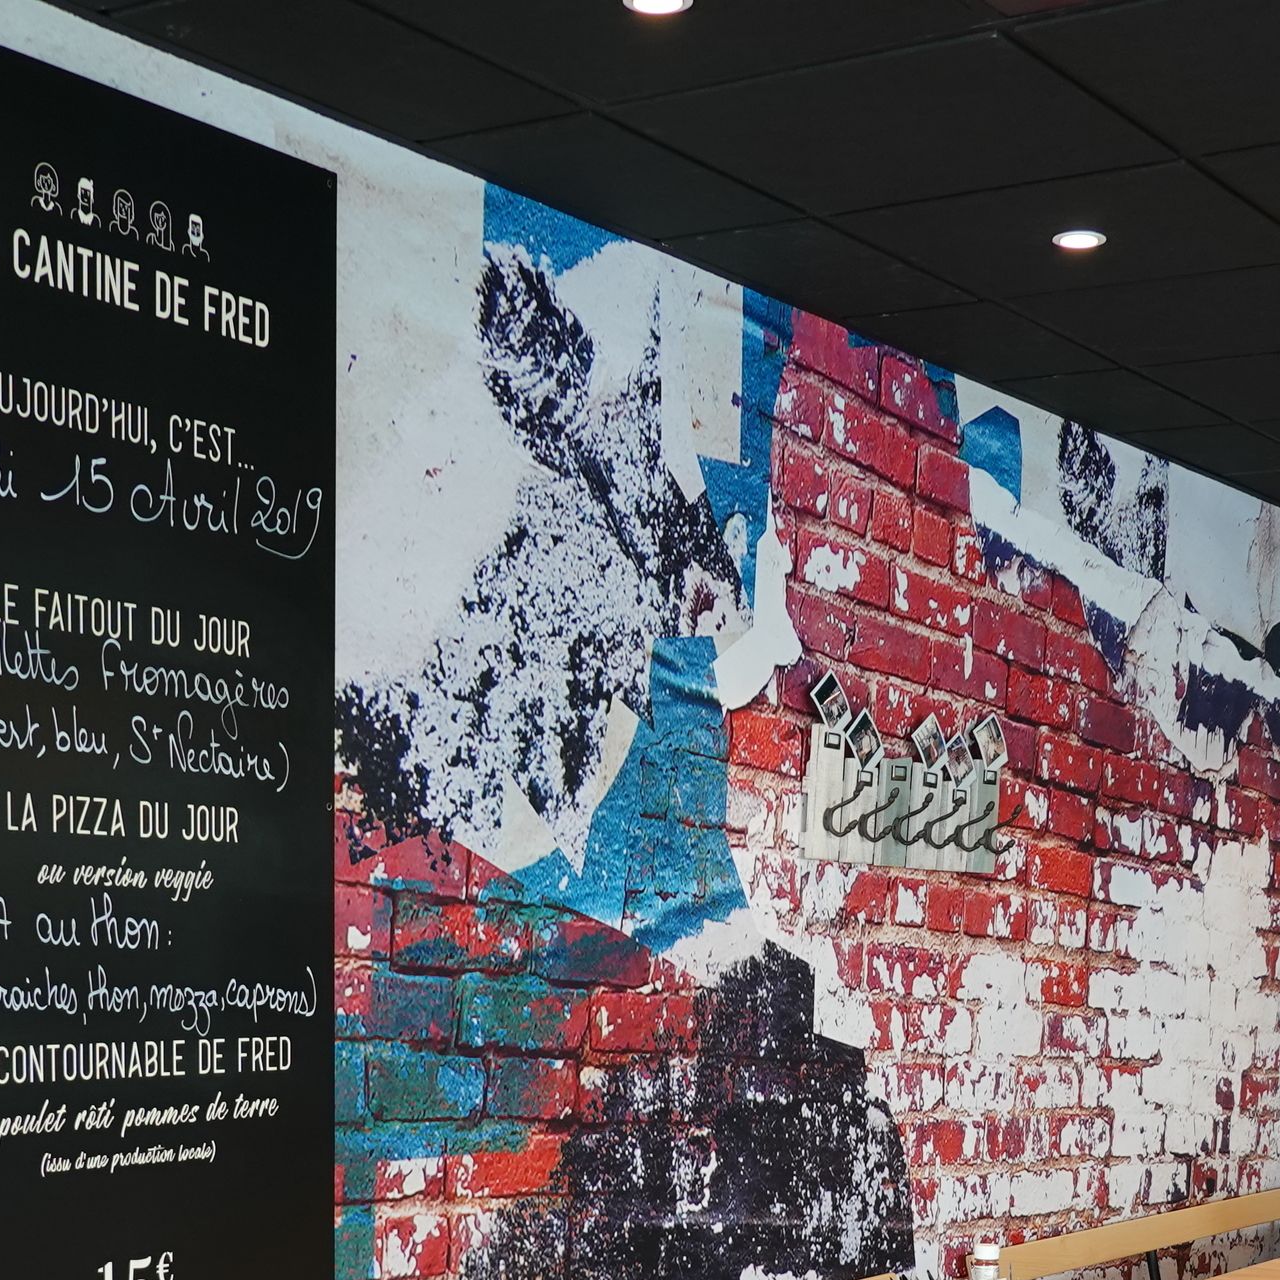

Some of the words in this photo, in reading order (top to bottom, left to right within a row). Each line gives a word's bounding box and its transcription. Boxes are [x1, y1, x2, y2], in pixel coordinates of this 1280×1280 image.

[13, 229, 139, 311] CANTINE
[156, 271, 189, 325] DE
[205, 286, 269, 347] FRED
[41, 455, 113, 512] 15
[131, 458, 240, 534] Avril
[251, 476, 322, 559] 2019
[35, 588, 136, 641] FAITOUT
[152, 607, 179, 647] DU
[194, 615, 249, 658] JOUR
[169, 710, 289, 792] Nectaire)
[7, 791, 37, 831] LA
[53, 795, 125, 837] PIZZA
[140, 801, 168, 839] DU
[182, 804, 238, 843] JOUR
[37, 864, 66, 884] ou
[73, 856, 147, 888] version
[154, 860, 214, 902] veggie
[36, 913, 80, 946] au
[199, 1039, 225, 1074] DE
[238, 1036, 291, 1072] FRED
[74, 1098, 115, 1130] rôti
[121, 1104, 199, 1138] pommes
[206, 1091, 228, 1121] de
[233, 1094, 279, 1119] terre
[41, 1153, 71, 1177] (issu
[75, 1151, 109, 1169] d'une
[111, 1145, 176, 1173] production
[178, 1140, 216, 1162] locale)
